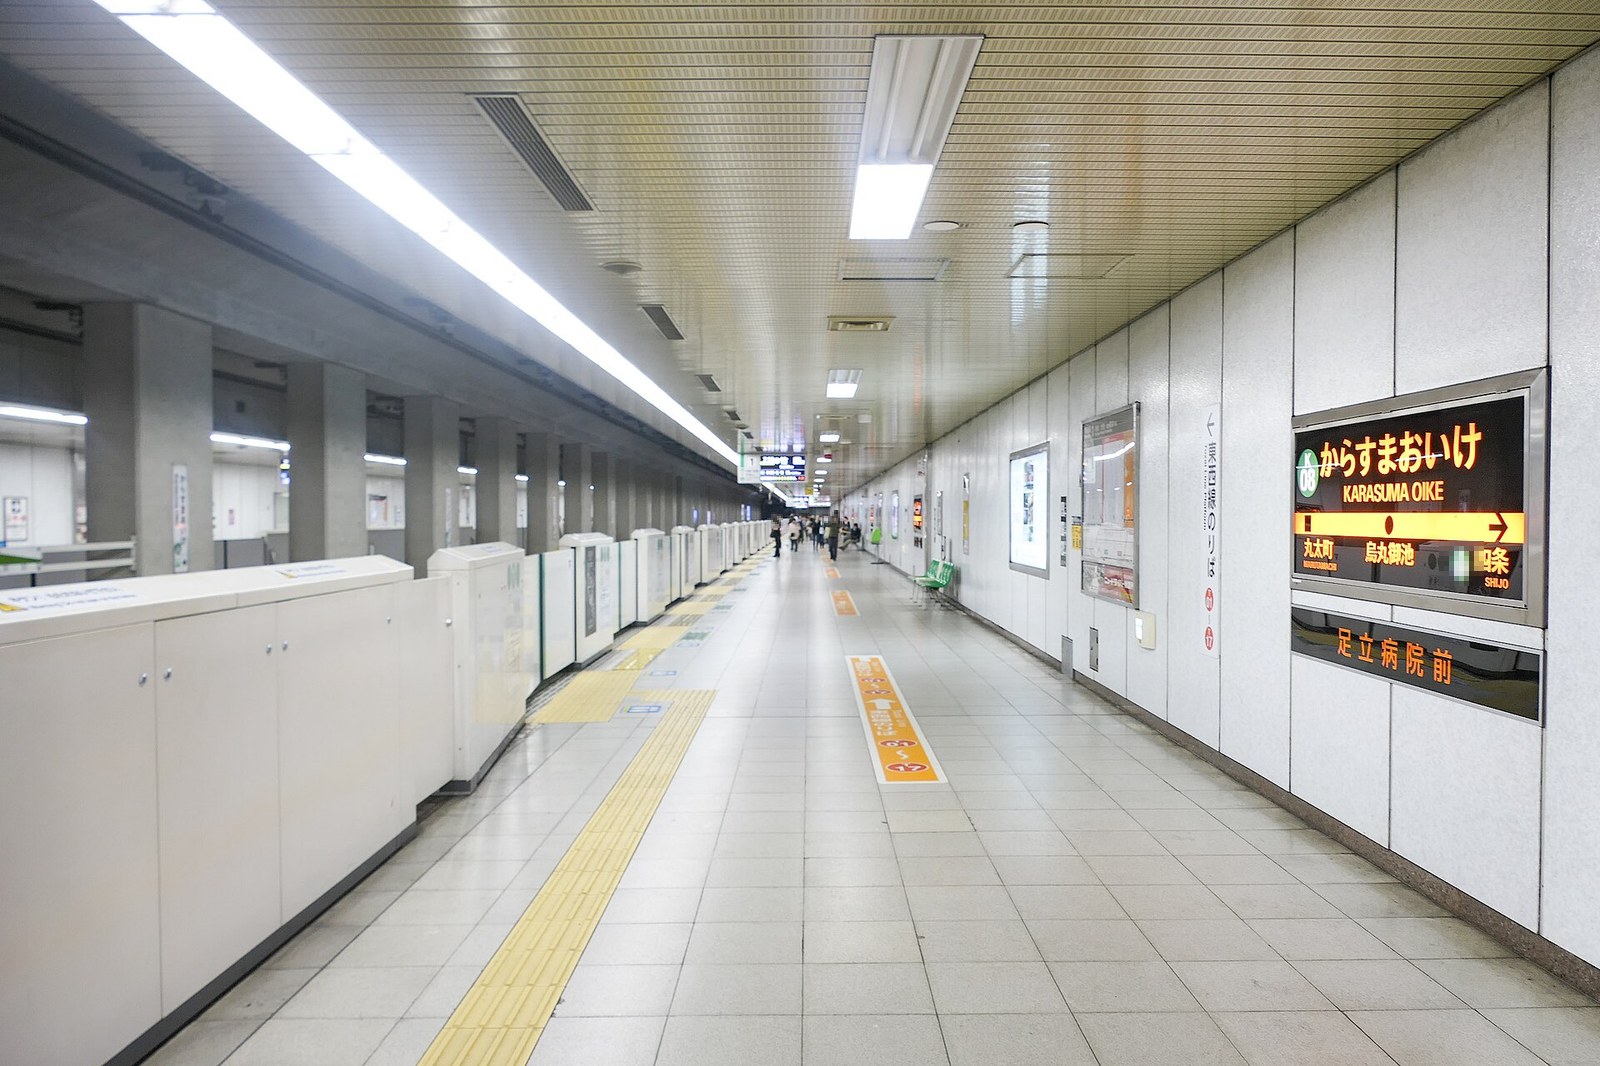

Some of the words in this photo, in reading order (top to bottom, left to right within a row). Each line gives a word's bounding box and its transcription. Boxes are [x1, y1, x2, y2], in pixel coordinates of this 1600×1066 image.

[1304, 452, 1312, 468] K
[1319, 422, 1483, 478] からすまおいけ
[1300, 468, 1316, 492] 08
[1343, 483, 1409, 503] KARASUMA
[1411, 480, 1444, 502] OIKE
[1303, 537, 1335, 560] 丸太町
[1364, 540, 1415, 567] 烏丸御池
[1484, 576, 1510, 590] SHIJO
[1337, 627, 1453, 686] 足立病院前
